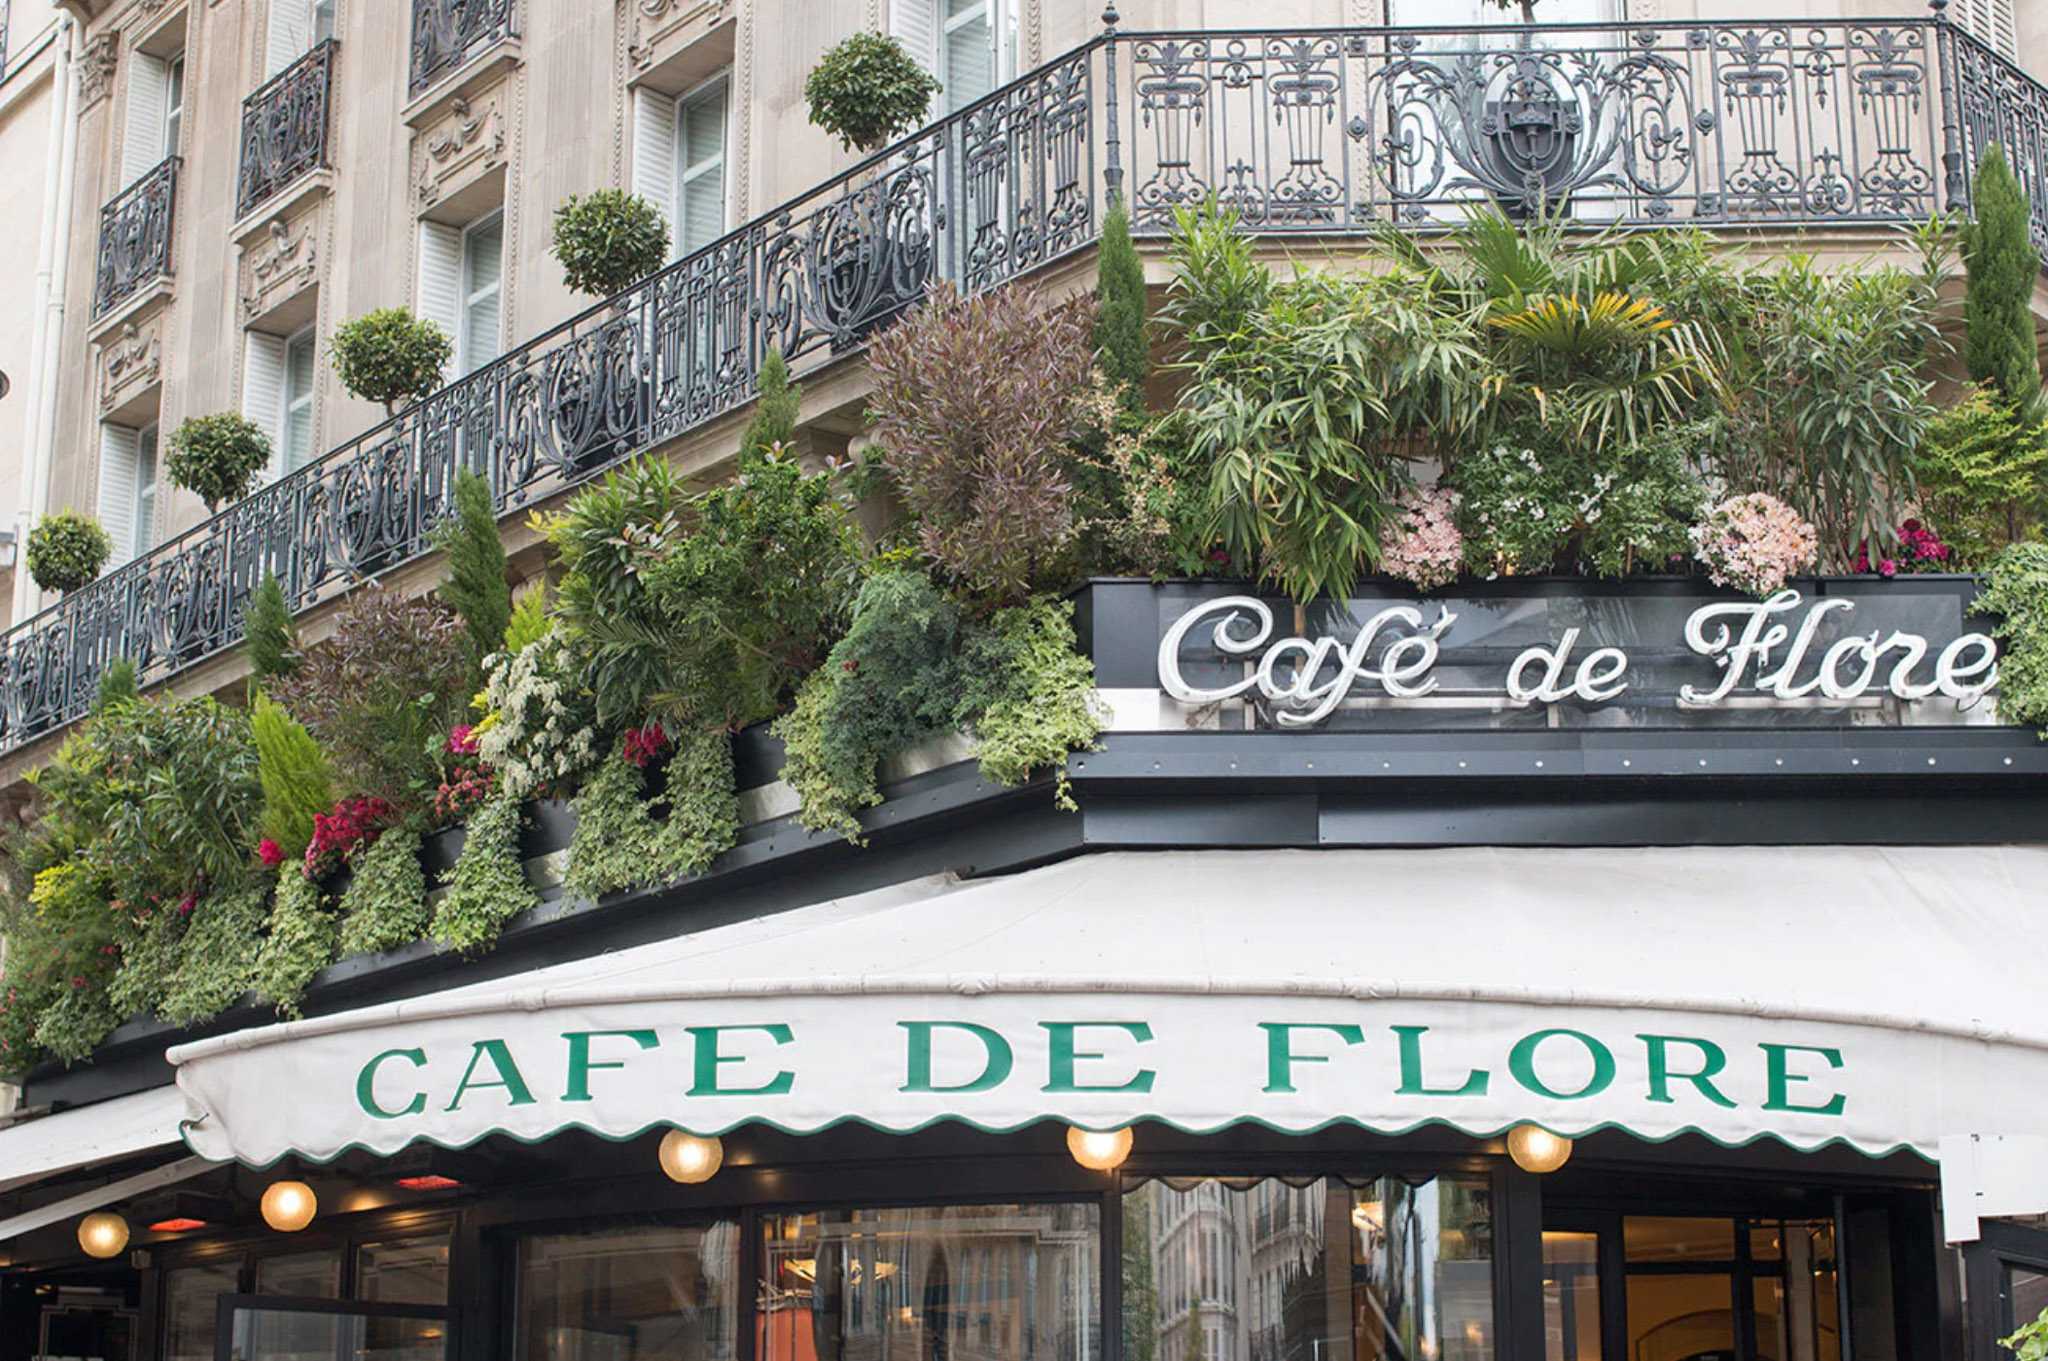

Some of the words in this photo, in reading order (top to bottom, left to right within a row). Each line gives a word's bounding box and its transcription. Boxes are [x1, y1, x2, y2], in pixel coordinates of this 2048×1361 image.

[1158, 596, 1458, 726] Café
[1505, 627, 1628, 703] de
[1679, 589, 2000, 705] Flore
[355, 1023, 795, 1119] CAFE
[896, 1020, 1157, 1094] DE
[1256, 1021, 1848, 1117] FLORE
